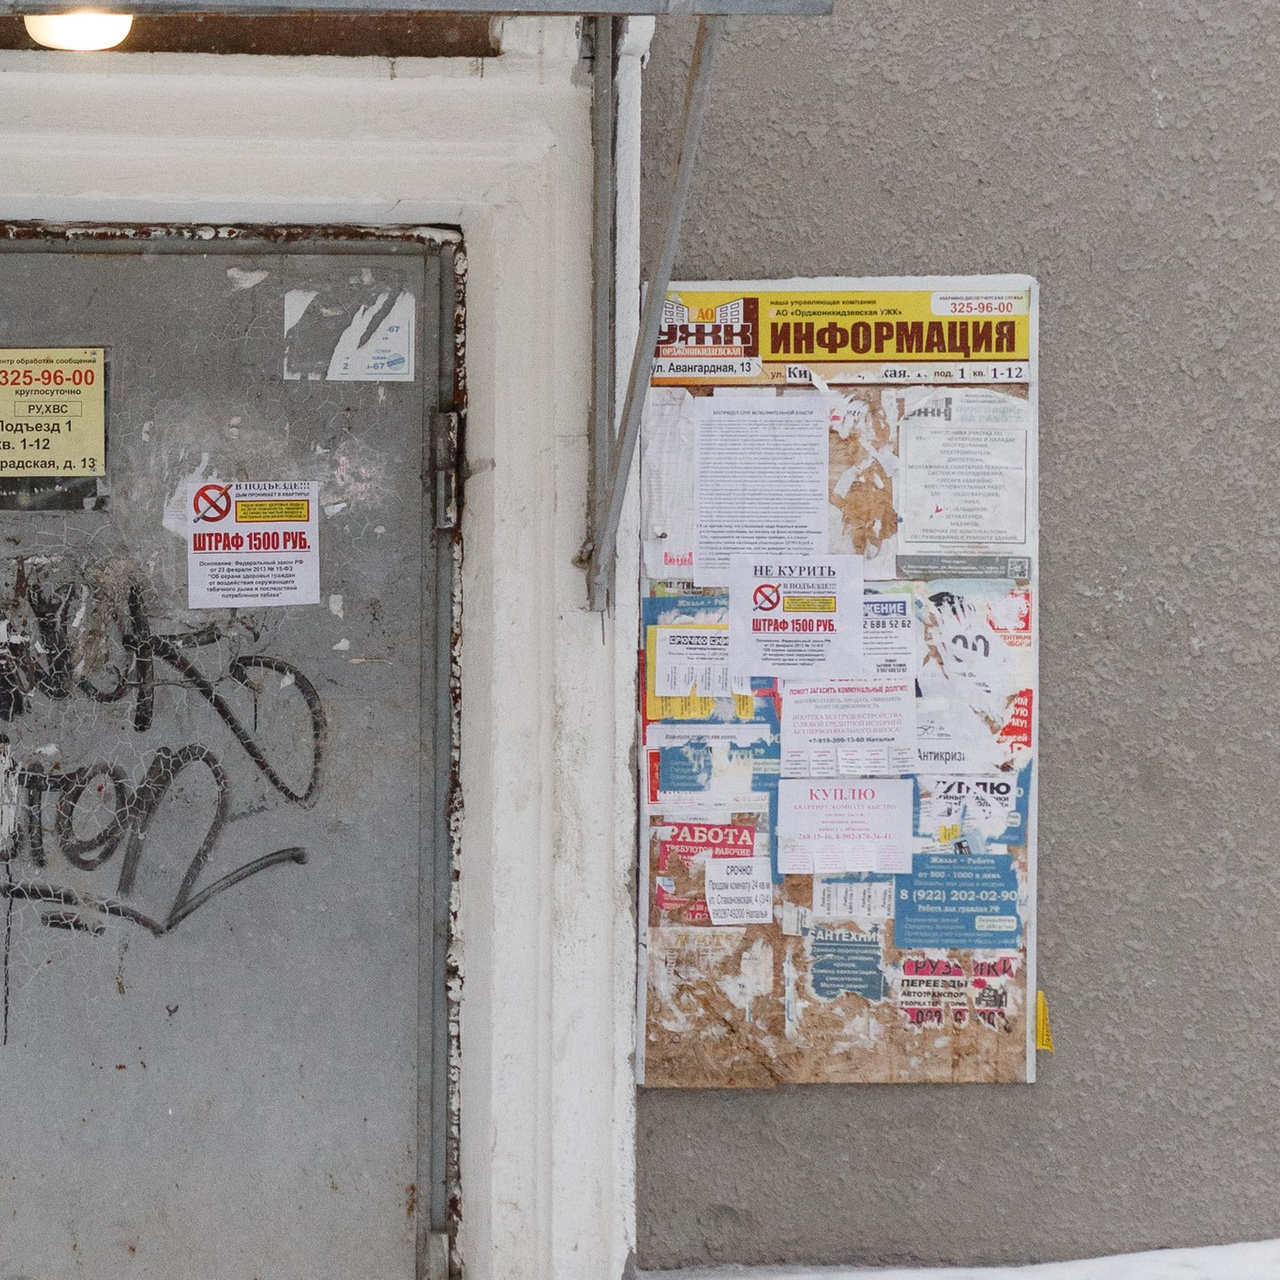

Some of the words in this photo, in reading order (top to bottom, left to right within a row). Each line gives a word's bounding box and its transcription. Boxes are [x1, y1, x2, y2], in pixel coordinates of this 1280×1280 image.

[697, 308, 715, 320] АО
[950, 302, 1013, 313] 325-96-00
[657, 324, 752, 345] УЖК
[771, 321, 1016, 358] ИНФОРМАЦИЯ
[668, 362, 737, 375] Авангардная,
[740, 362, 752, 373] 13
[771, 371, 785, 380] ул.
[934, 371, 954, 379] под.
[959, 367, 965, 378] 1
[991, 367, 1024, 378] 1-12
[15, 388, 82, 396] круглосуточно
[28, 404, 68, 414] РУ,ХВС
[65, 420, 72, 432] 1
[20, 438, 50, 450] 1-12
[63, 460, 76, 471] д.
[81, 457, 96, 468] 13
[244, 482, 310, 491] ПОДЪЕЗДЕ!!!
[193, 532, 244, 552] ШТРАФ
[247, 531, 280, 550] 1500
[283, 531, 310, 550] РУБ.
[753, 565, 773, 577] НЕ
[778, 565, 836, 577] КУРИТЬ
[752, 618, 789, 632] ШТРАФ
[790, 619, 814, 632] 1500
[816, 619, 837, 632] РУБ.
[809, 788, 876, 801] КУПЛЮ
[669, 826, 753, 845] РАБОТА
[900, 889, 909, 900] 8
[913, 889, 947, 903] (922)
[950, 890, 1018, 901] 202-02-90
